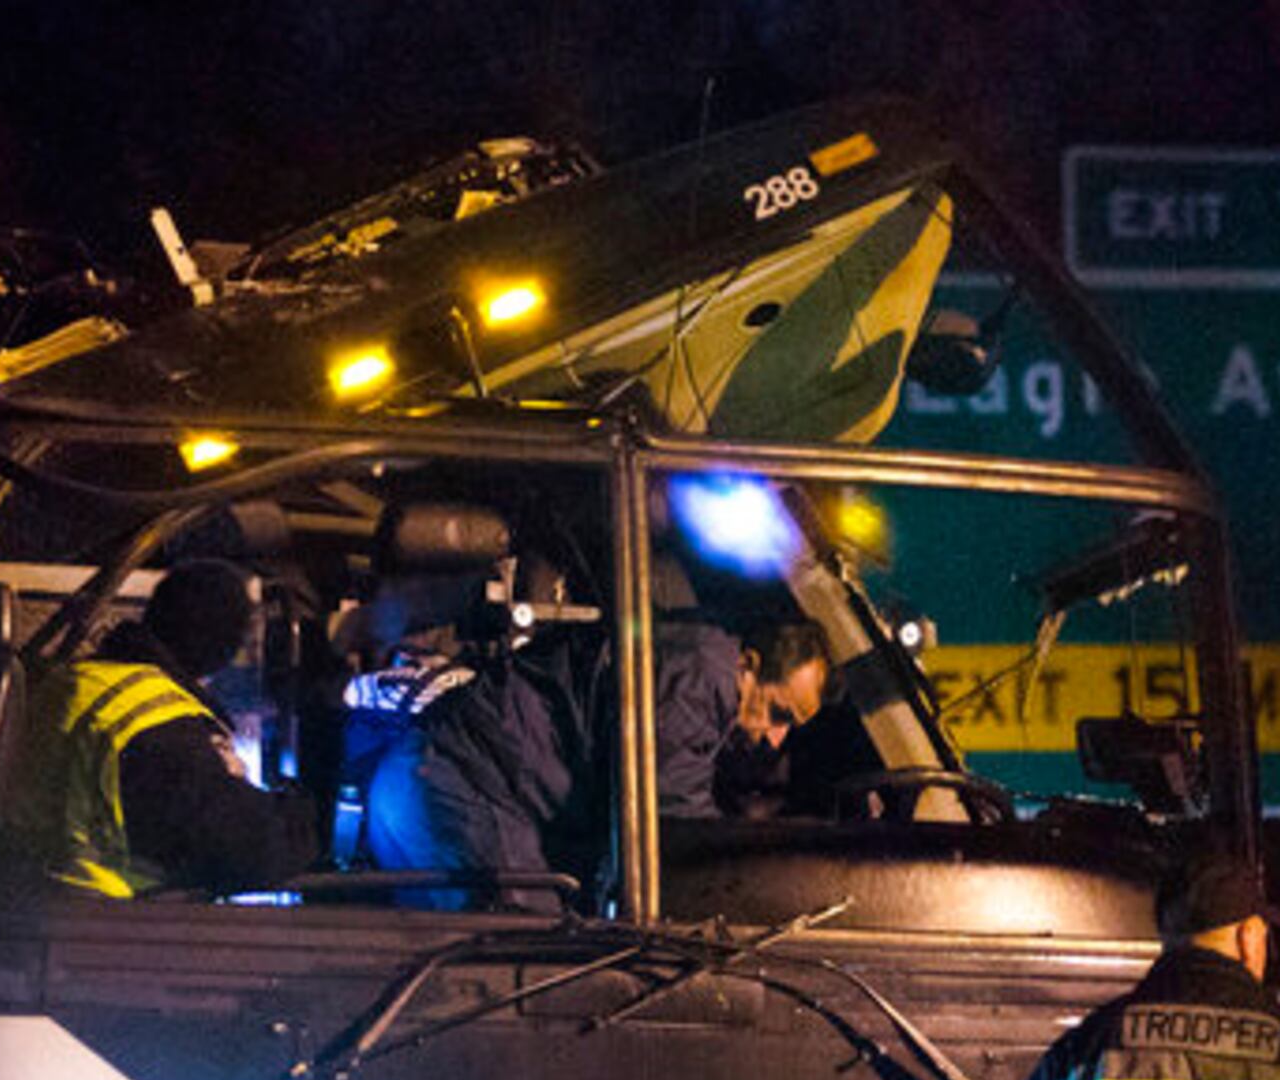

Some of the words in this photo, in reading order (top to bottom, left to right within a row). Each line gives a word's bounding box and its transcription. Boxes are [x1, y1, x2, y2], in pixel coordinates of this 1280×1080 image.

[743, 166, 819, 222] 288
[1107, 187, 1226, 240] EXIT
[928, 670, 1068, 726] EXIT
[1116, 663, 1189, 722] 15
[1127, 1012, 1280, 1049] TROOPER
